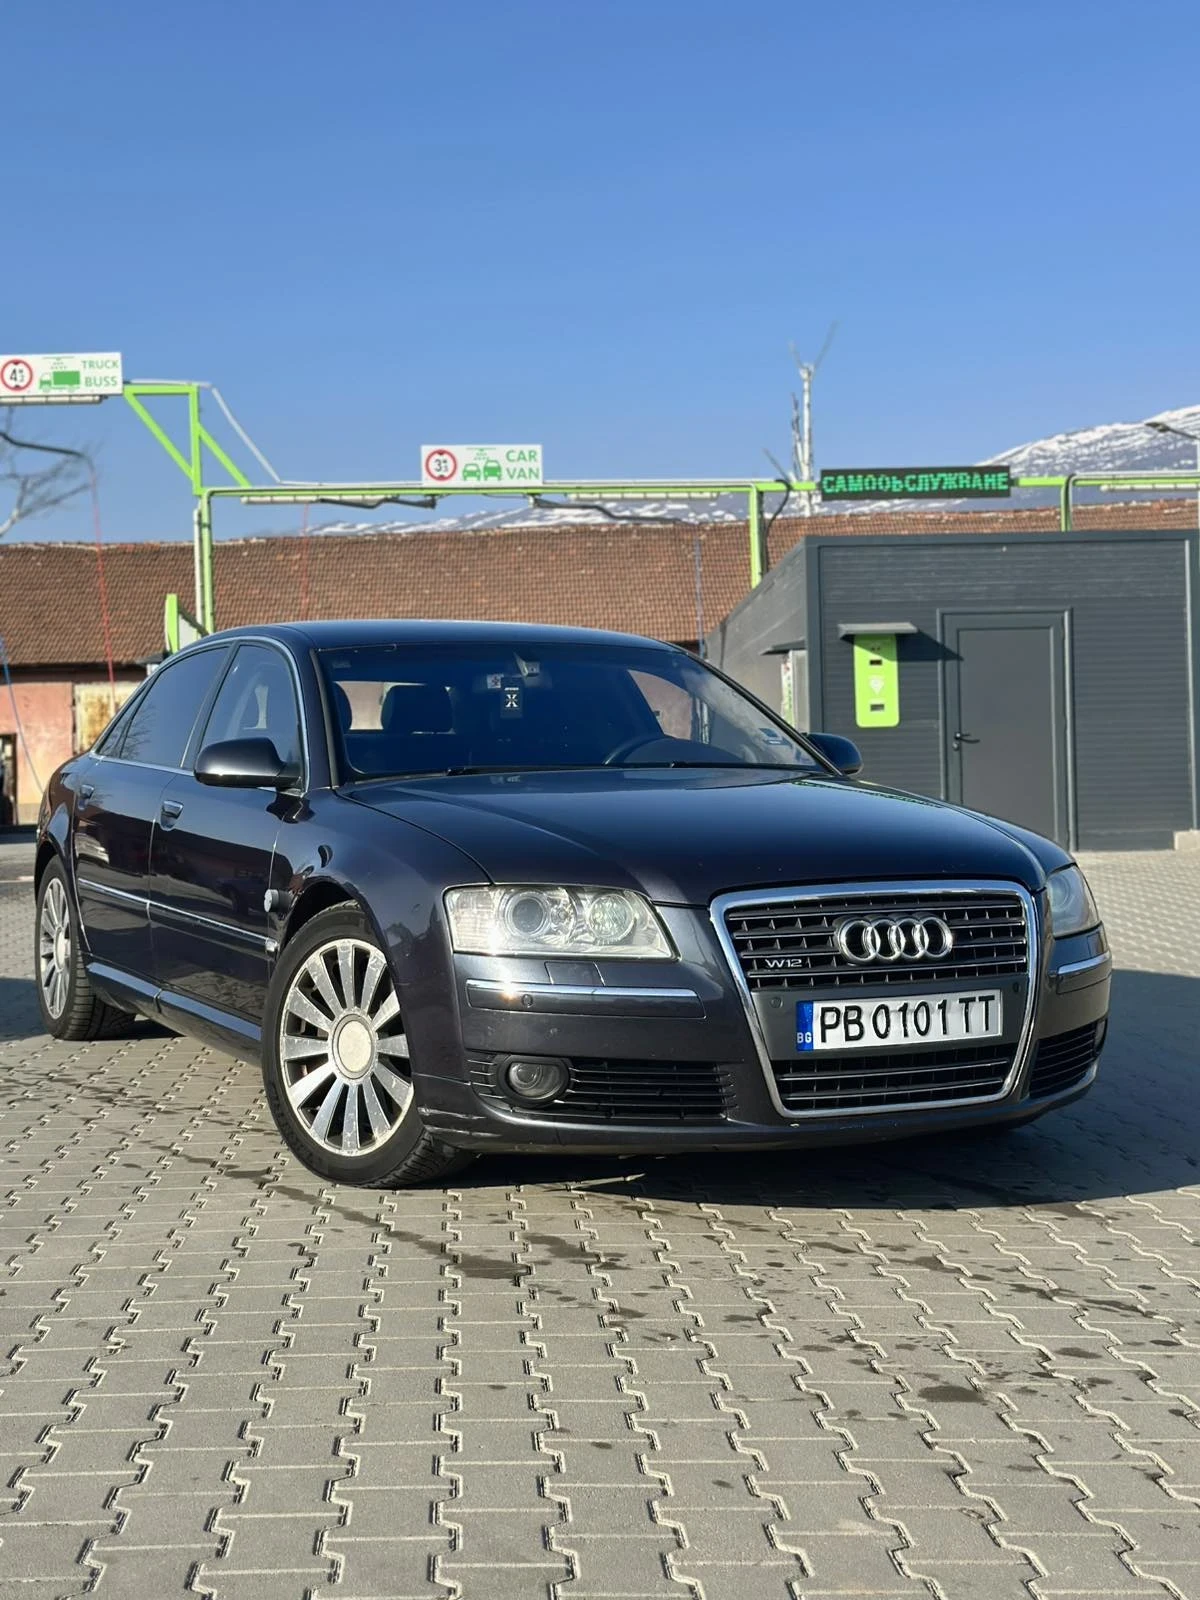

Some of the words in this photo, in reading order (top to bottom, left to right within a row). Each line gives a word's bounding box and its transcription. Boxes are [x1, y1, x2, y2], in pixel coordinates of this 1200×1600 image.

[81, 360, 119, 369] TRUCK
[85, 376, 118, 387] BUSS
[506, 449, 537, 462] CAR
[506, 467, 540, 480] VAN
[764, 958, 803, 968] W12
[819, 1005, 865, 1043] PB
[871, 999, 949, 1040] 0101
[958, 995, 996, 1034] TT
[796, 1031, 812, 1044] BG
